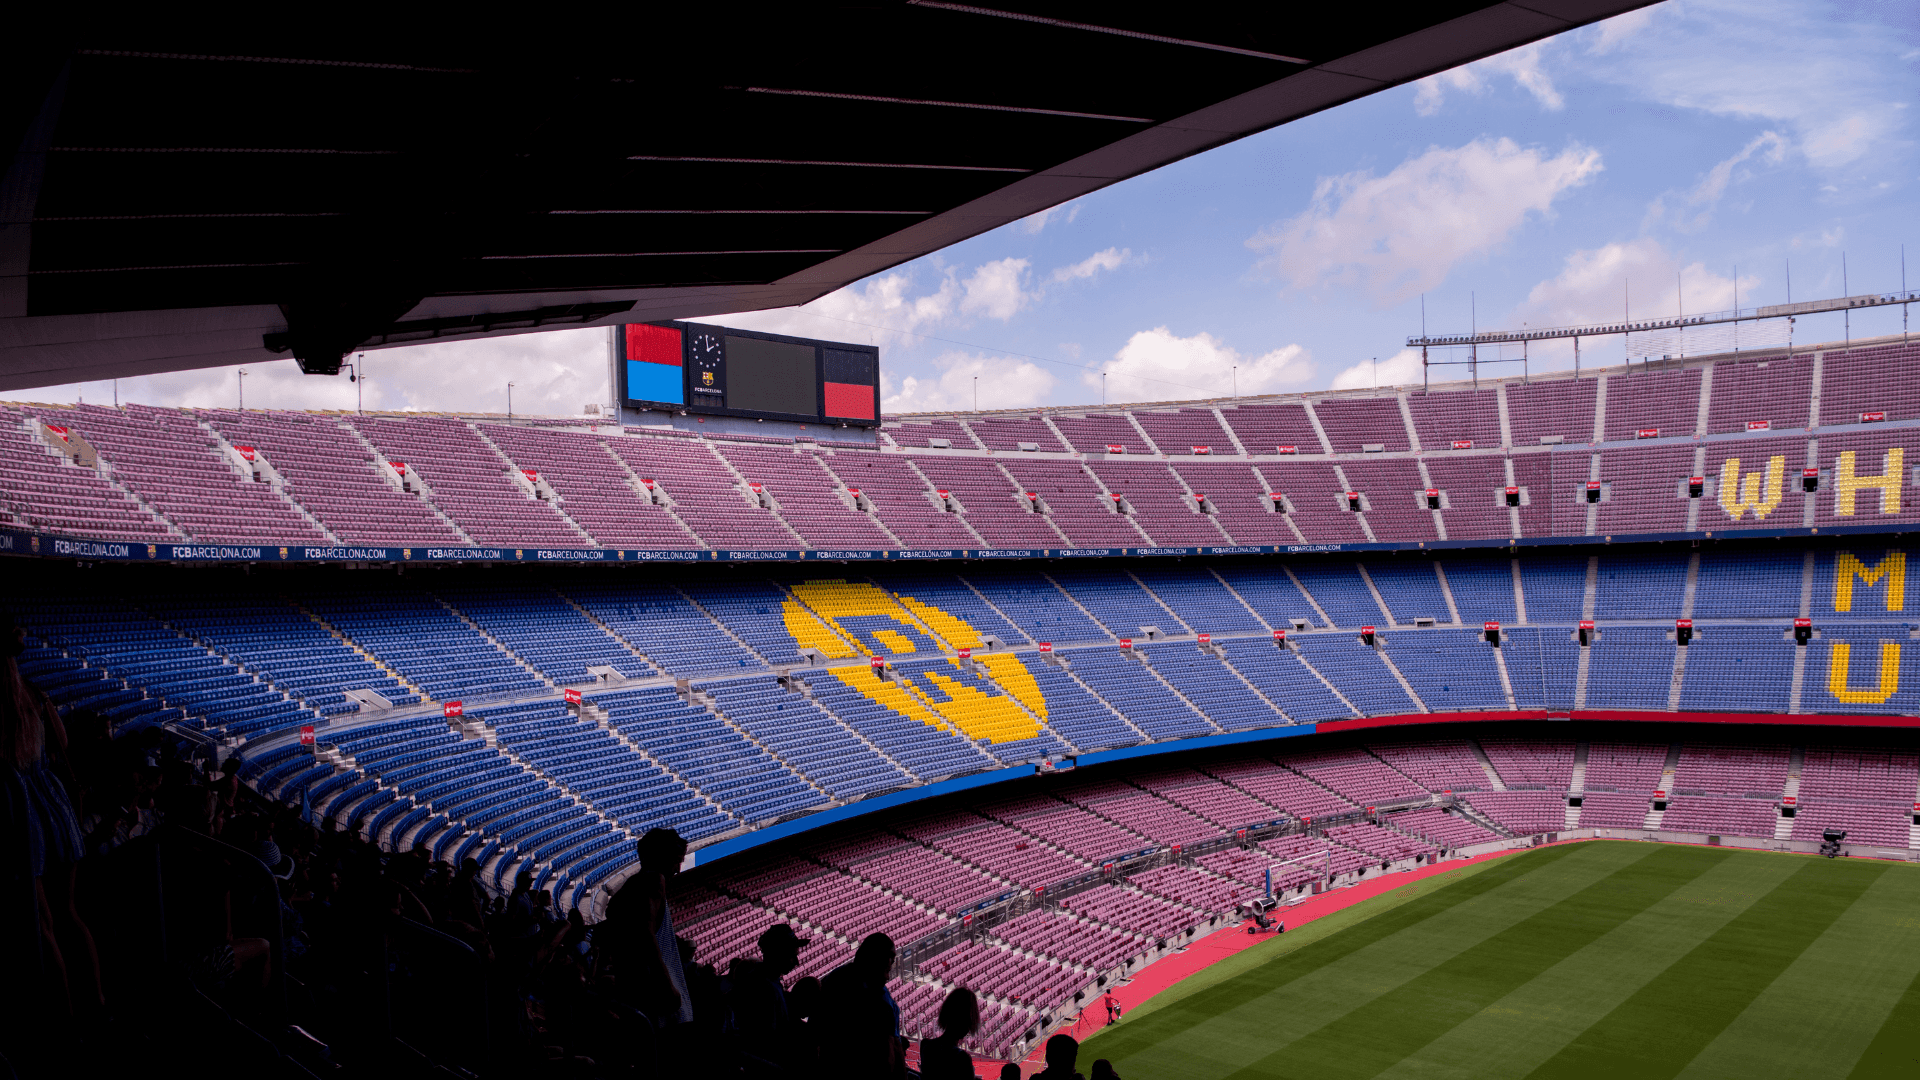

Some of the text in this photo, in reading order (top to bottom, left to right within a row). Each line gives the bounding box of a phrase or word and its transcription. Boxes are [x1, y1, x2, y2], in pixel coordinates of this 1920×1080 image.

[55, 540, 129, 556] FCBARCELONA.COM
[172, 547, 261, 559] FCBARCELONA.COM
[305, 548, 386, 559] FCBARCELONA.COM
[427, 549, 500, 559] FCBARCELONA.COM
[537, 550, 604, 559] FCBARCELONA.COM
[637, 551, 698, 560] FCBARCELONA.COM
[729, 551, 787, 560] FCBARCELONA.COM
[816, 551, 872, 559] FCBARCELONA.COM
[899, 550, 952, 558] FCBARCELONA.COM
